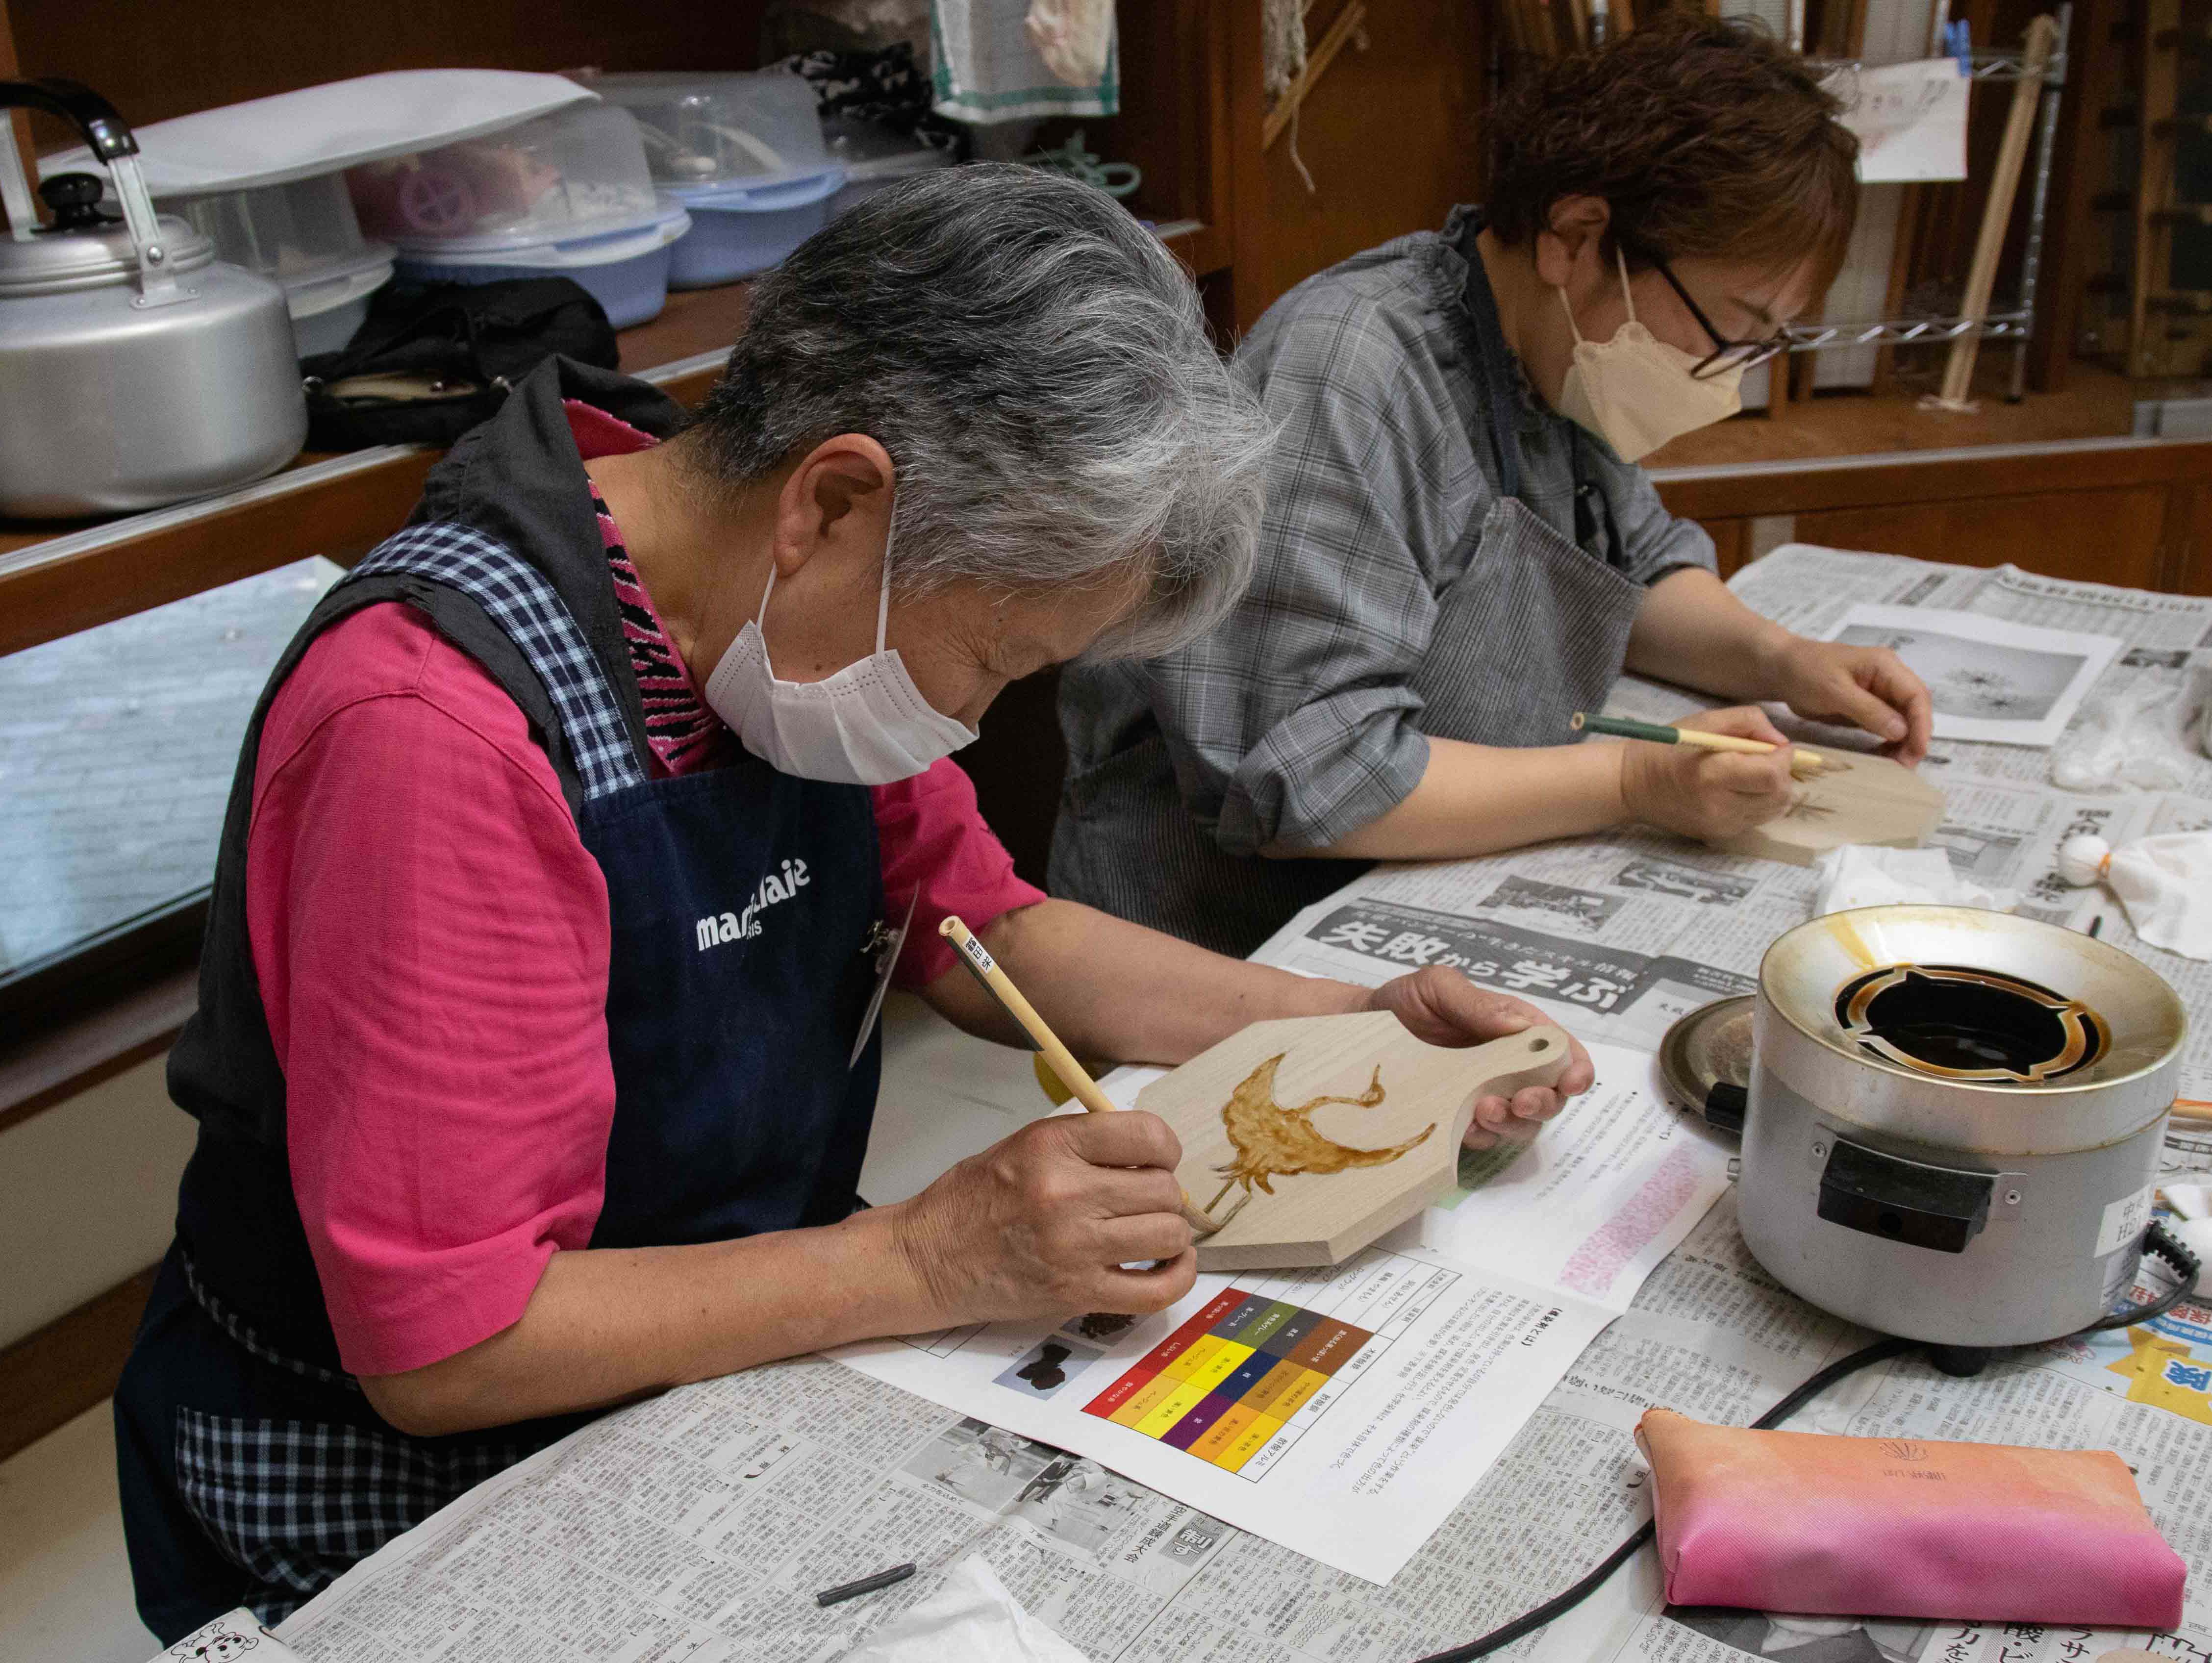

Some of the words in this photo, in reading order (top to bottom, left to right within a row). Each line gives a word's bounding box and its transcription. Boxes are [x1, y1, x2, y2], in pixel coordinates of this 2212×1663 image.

[1321, 920, 1635, 1009] 失敗から学ぶ
[1307, 1393, 1332, 1412] 酢酸銅
[1256, 1437, 1288, 1466] 酢酸アルミ
[921, 1483, 965, 1505] 全力を込めて
